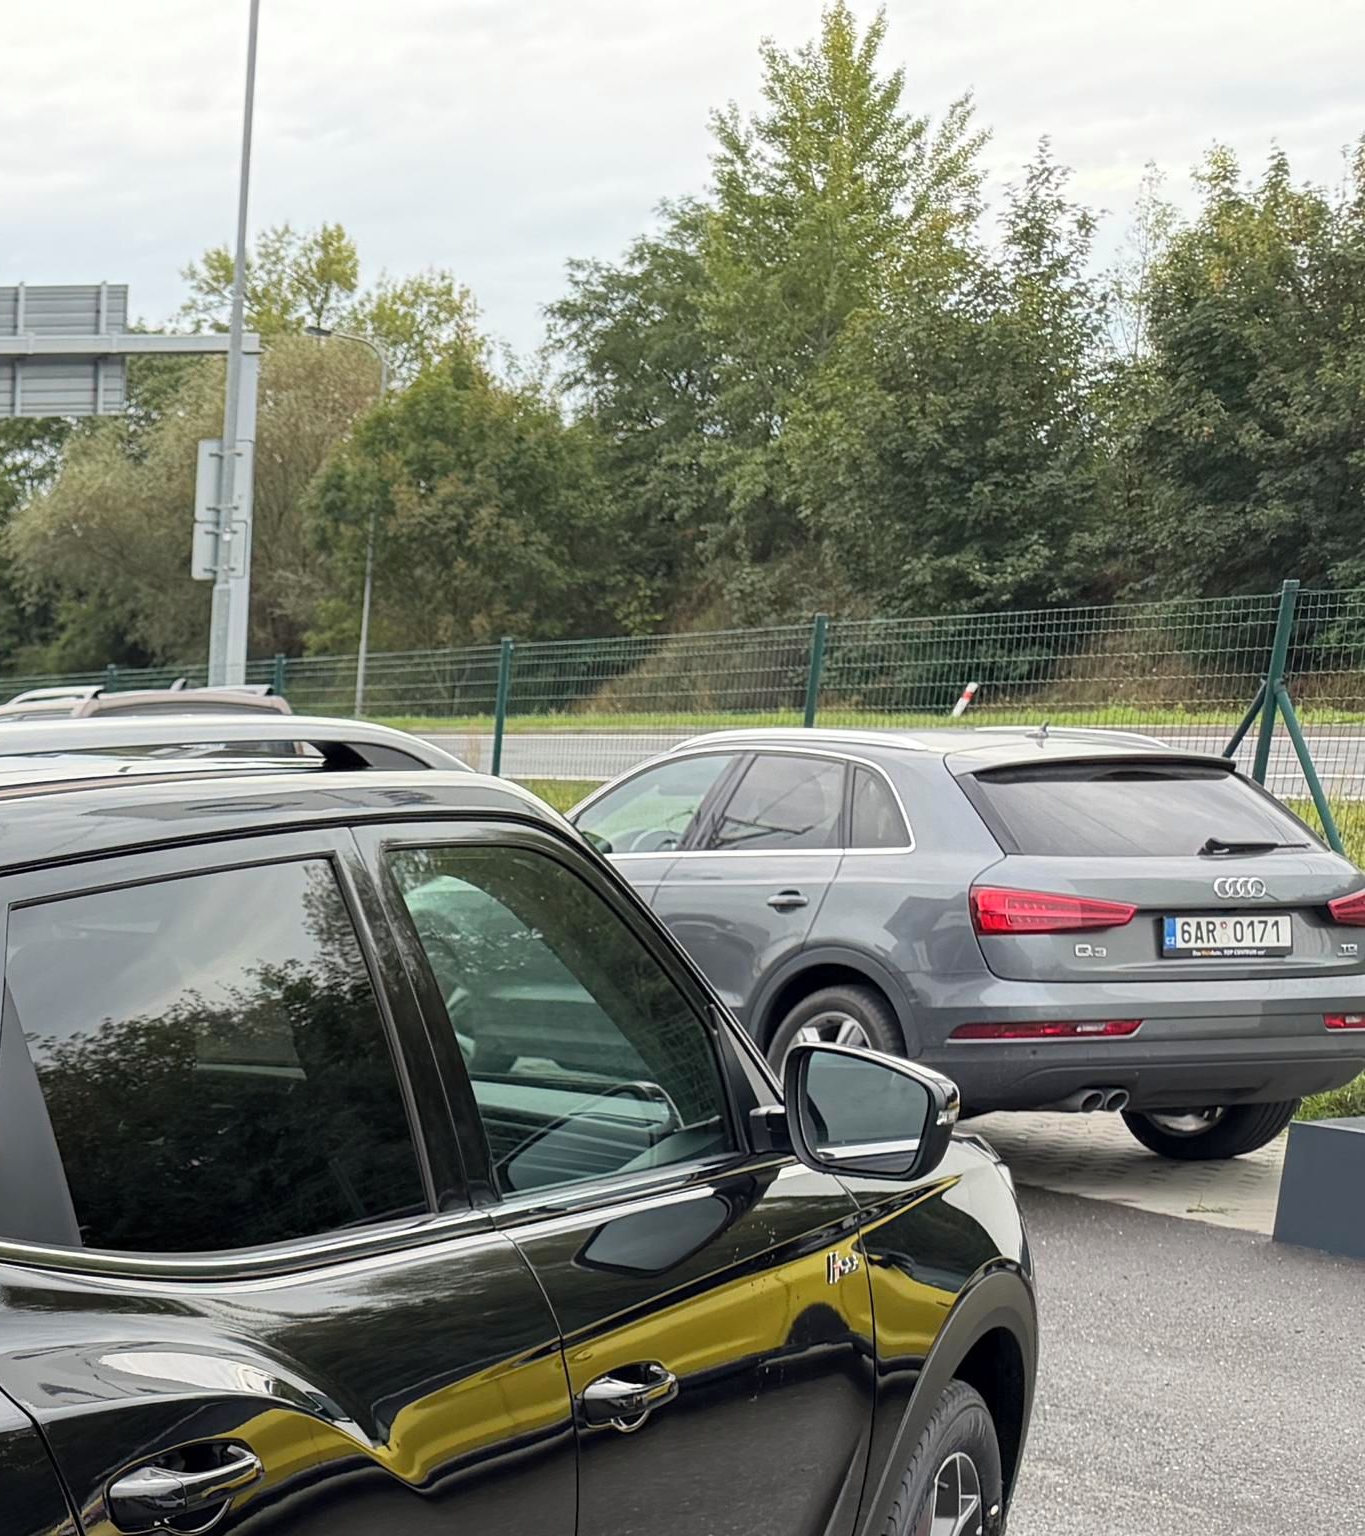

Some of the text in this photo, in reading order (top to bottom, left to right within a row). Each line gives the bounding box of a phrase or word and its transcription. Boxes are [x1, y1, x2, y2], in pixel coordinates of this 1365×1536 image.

[1181, 919, 1280, 944] 6AR 0171
[1075, 944, 1107, 957] Q3
